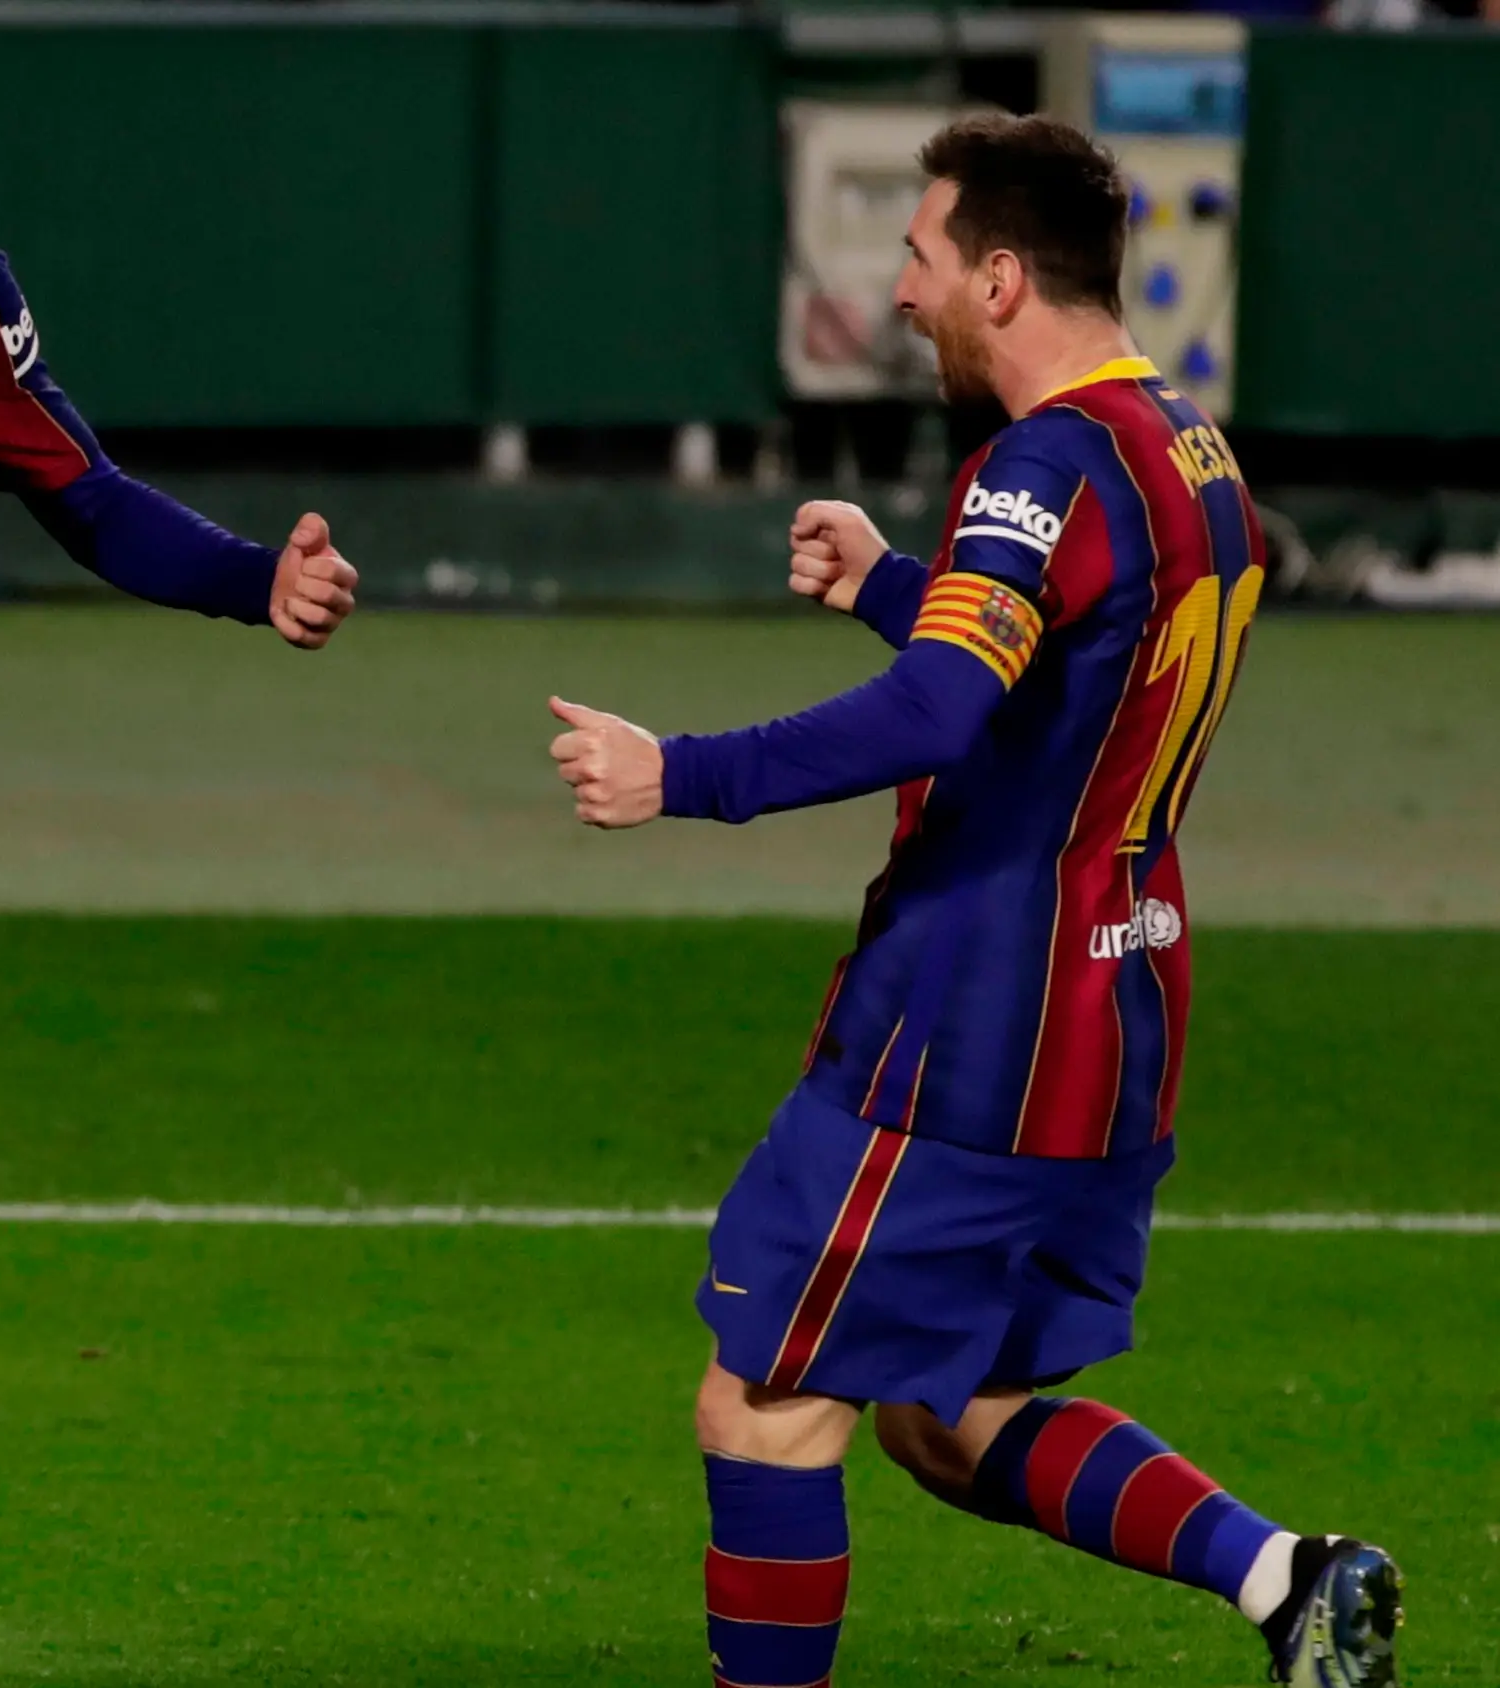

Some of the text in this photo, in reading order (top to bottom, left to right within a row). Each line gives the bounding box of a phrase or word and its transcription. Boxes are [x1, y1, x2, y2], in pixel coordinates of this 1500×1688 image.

[0, 307, 34, 356] be
[1166, 425, 1242, 499] MESS
[962, 481, 1061, 543] beko
[1114, 564, 1265, 855] 10
